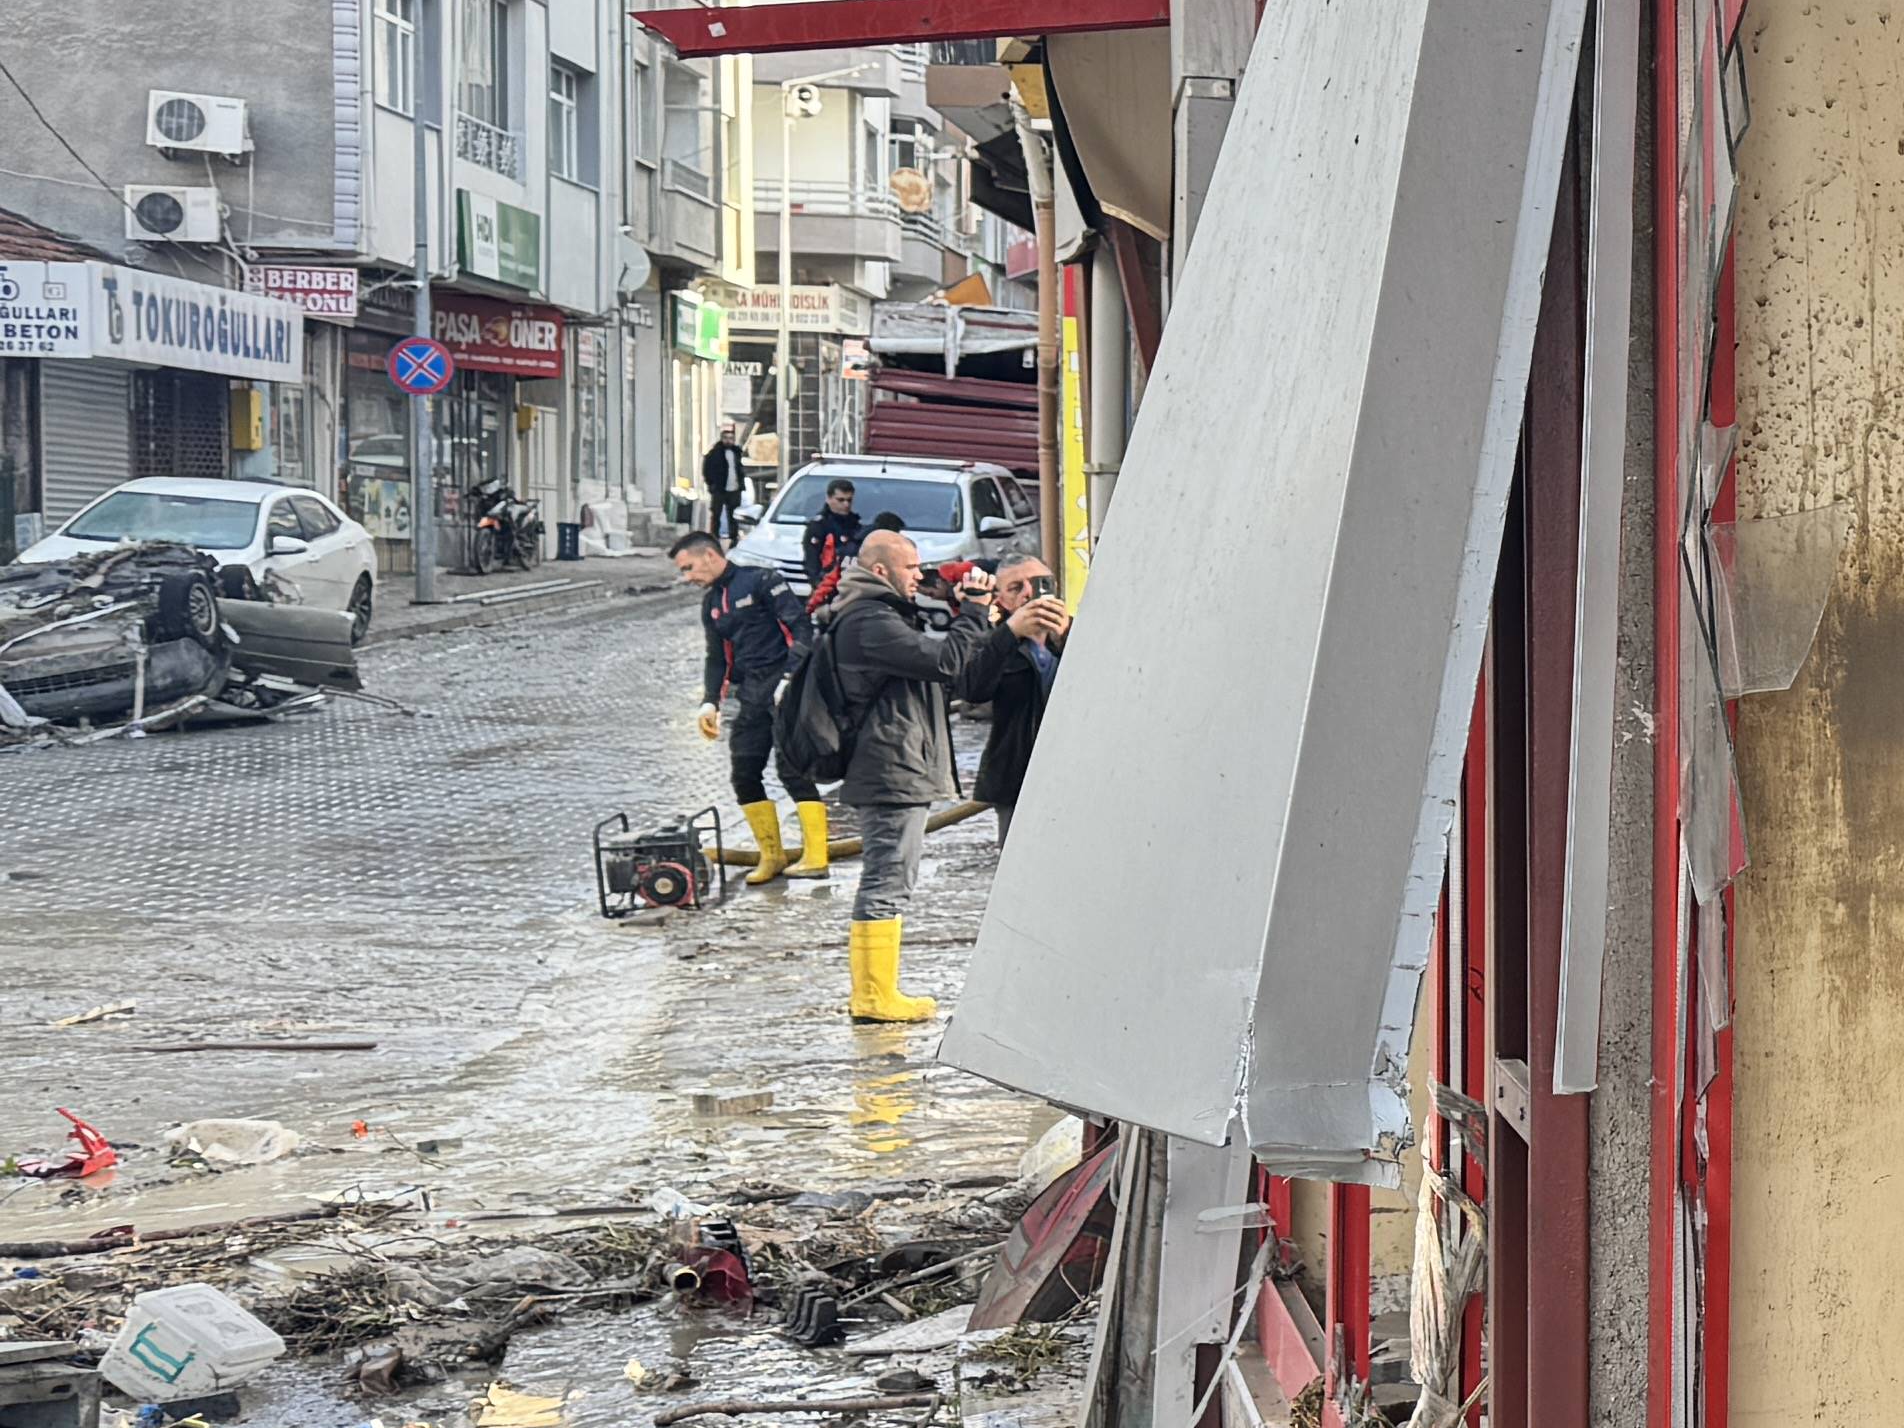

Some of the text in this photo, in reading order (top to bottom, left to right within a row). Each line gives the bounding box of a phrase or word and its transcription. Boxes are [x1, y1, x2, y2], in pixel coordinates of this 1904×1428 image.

[267, 270, 354, 291] BERBER
[751, 290, 829, 310] MÜHDİSLİK
[4, 323, 79, 340] BETON
[132, 289, 291, 364] TOKUROĞULLARI
[434, 311, 482, 350] PAŞA
